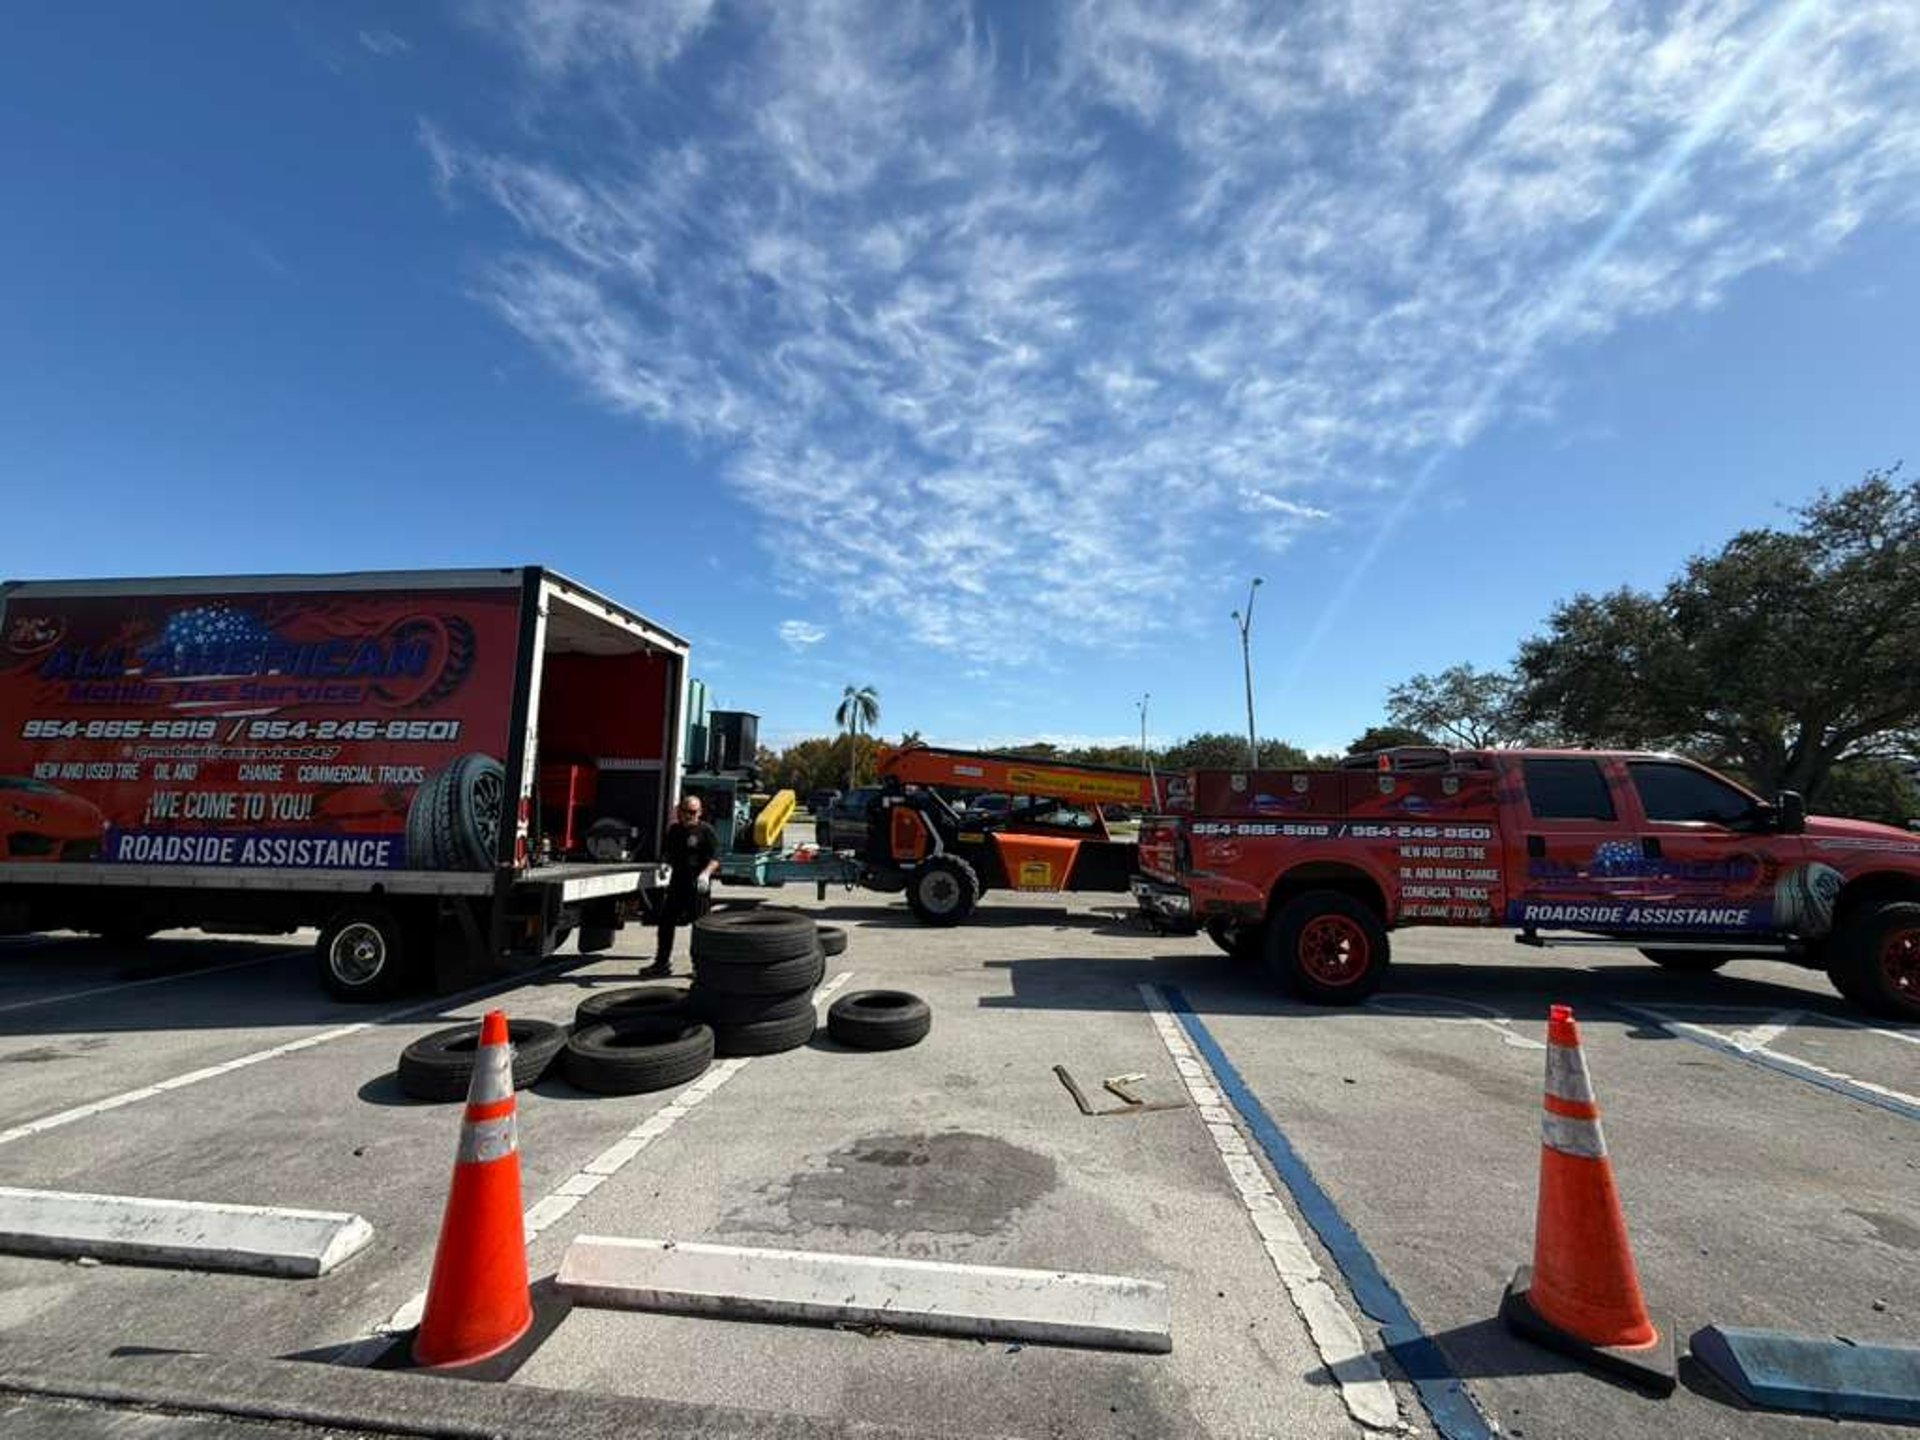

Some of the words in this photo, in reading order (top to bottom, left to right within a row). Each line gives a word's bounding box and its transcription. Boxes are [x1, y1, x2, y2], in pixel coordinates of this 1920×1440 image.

[240, 682, 362, 701] Service
[247, 719, 460, 741] 954-245-8501
[33, 763, 59, 780] NEW
[61, 763, 84, 780] AND
[85, 763, 113, 780] USED
[115, 763, 140, 780] TIRE
[154, 763, 173, 780] OIL
[174, 763, 199, 780] AND
[238, 764, 285, 782] CHANGE
[297, 765, 374, 783] COMMERCIAL
[376, 766, 424, 784] TRUCKS
[183, 790, 238, 820] COME
[241, 791, 265, 821] TO
[270, 792, 313, 821] YOU!
[117, 834, 234, 864] ROADSIDE
[240, 837, 392, 868] ASSISTANCE
[1422, 846, 1441, 859] AND
[1415, 867, 1434, 880] AND
[1524, 903, 1623, 924] ROADSIDE
[1625, 906, 1751, 927] ASSISTANCE
